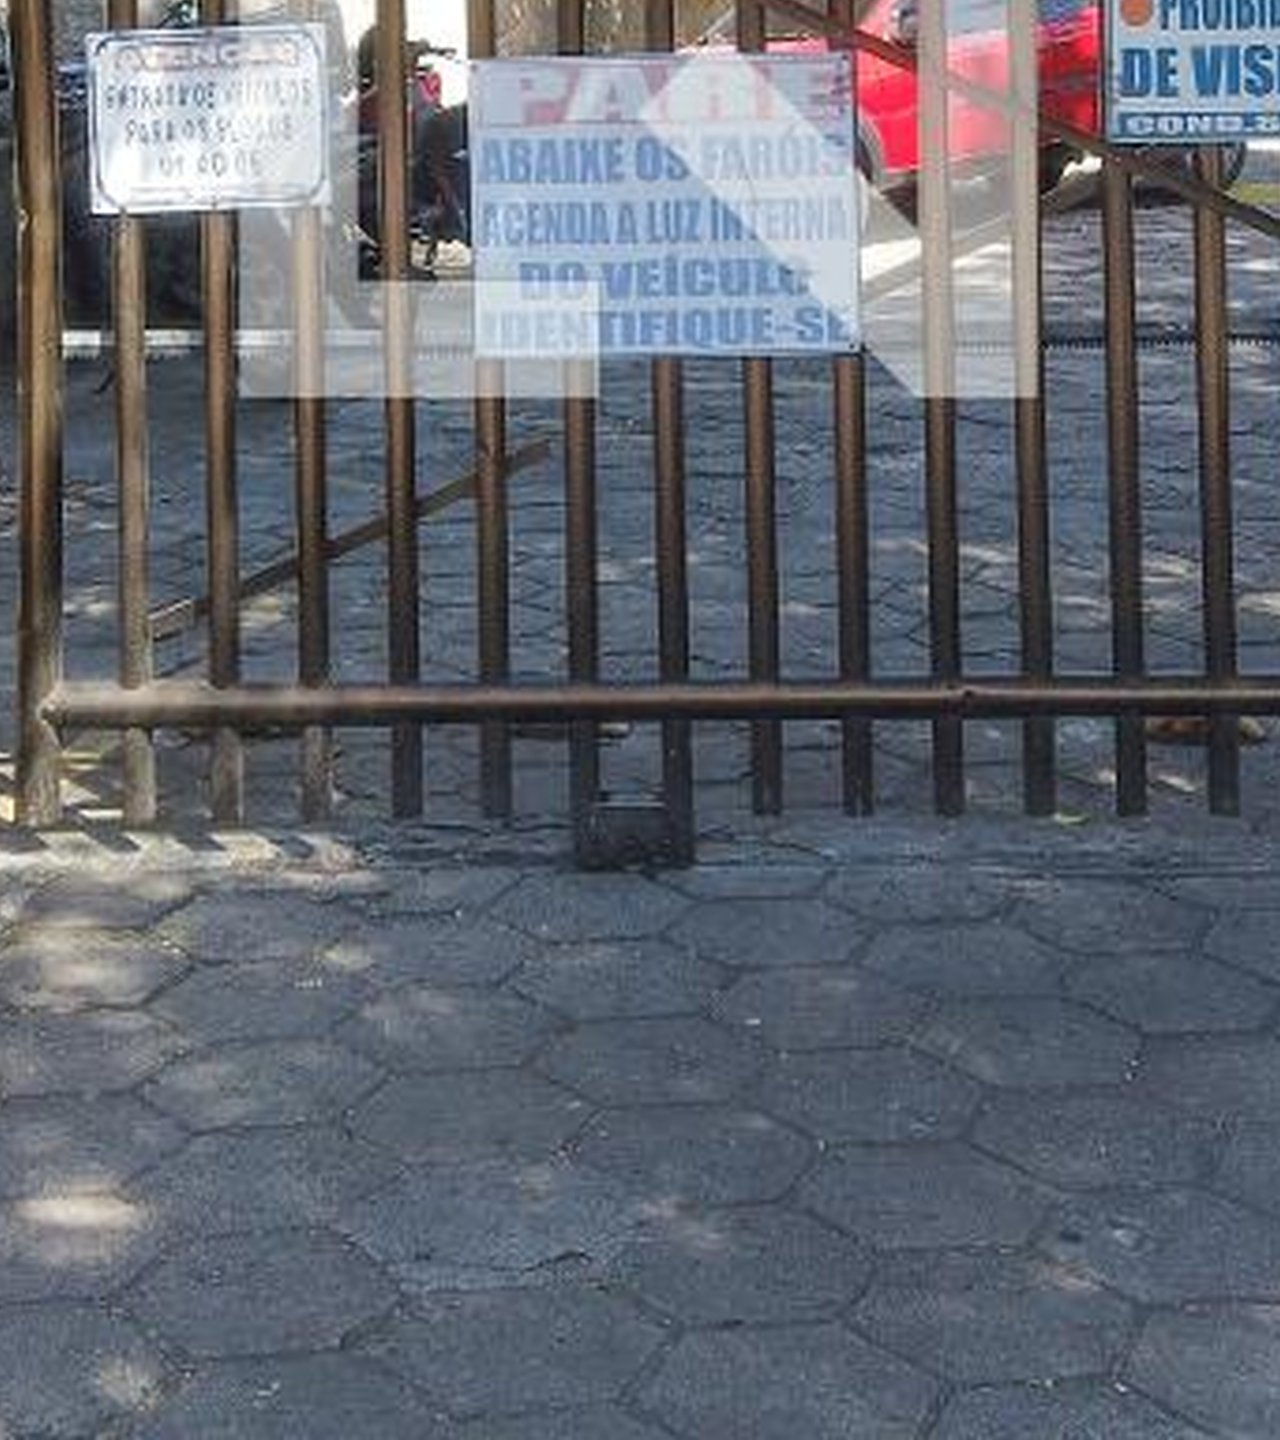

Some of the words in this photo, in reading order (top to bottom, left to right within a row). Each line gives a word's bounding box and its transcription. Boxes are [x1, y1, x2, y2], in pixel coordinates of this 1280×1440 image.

[1120, 48, 1177, 98] DE
[483, 137, 626, 184] ABAIXE
[634, 134, 689, 180] OS
[483, 200, 611, 245] ACENDA
[617, 201, 639, 244] A
[647, 200, 701, 242] LUZ
[519, 260, 588, 299] DO
